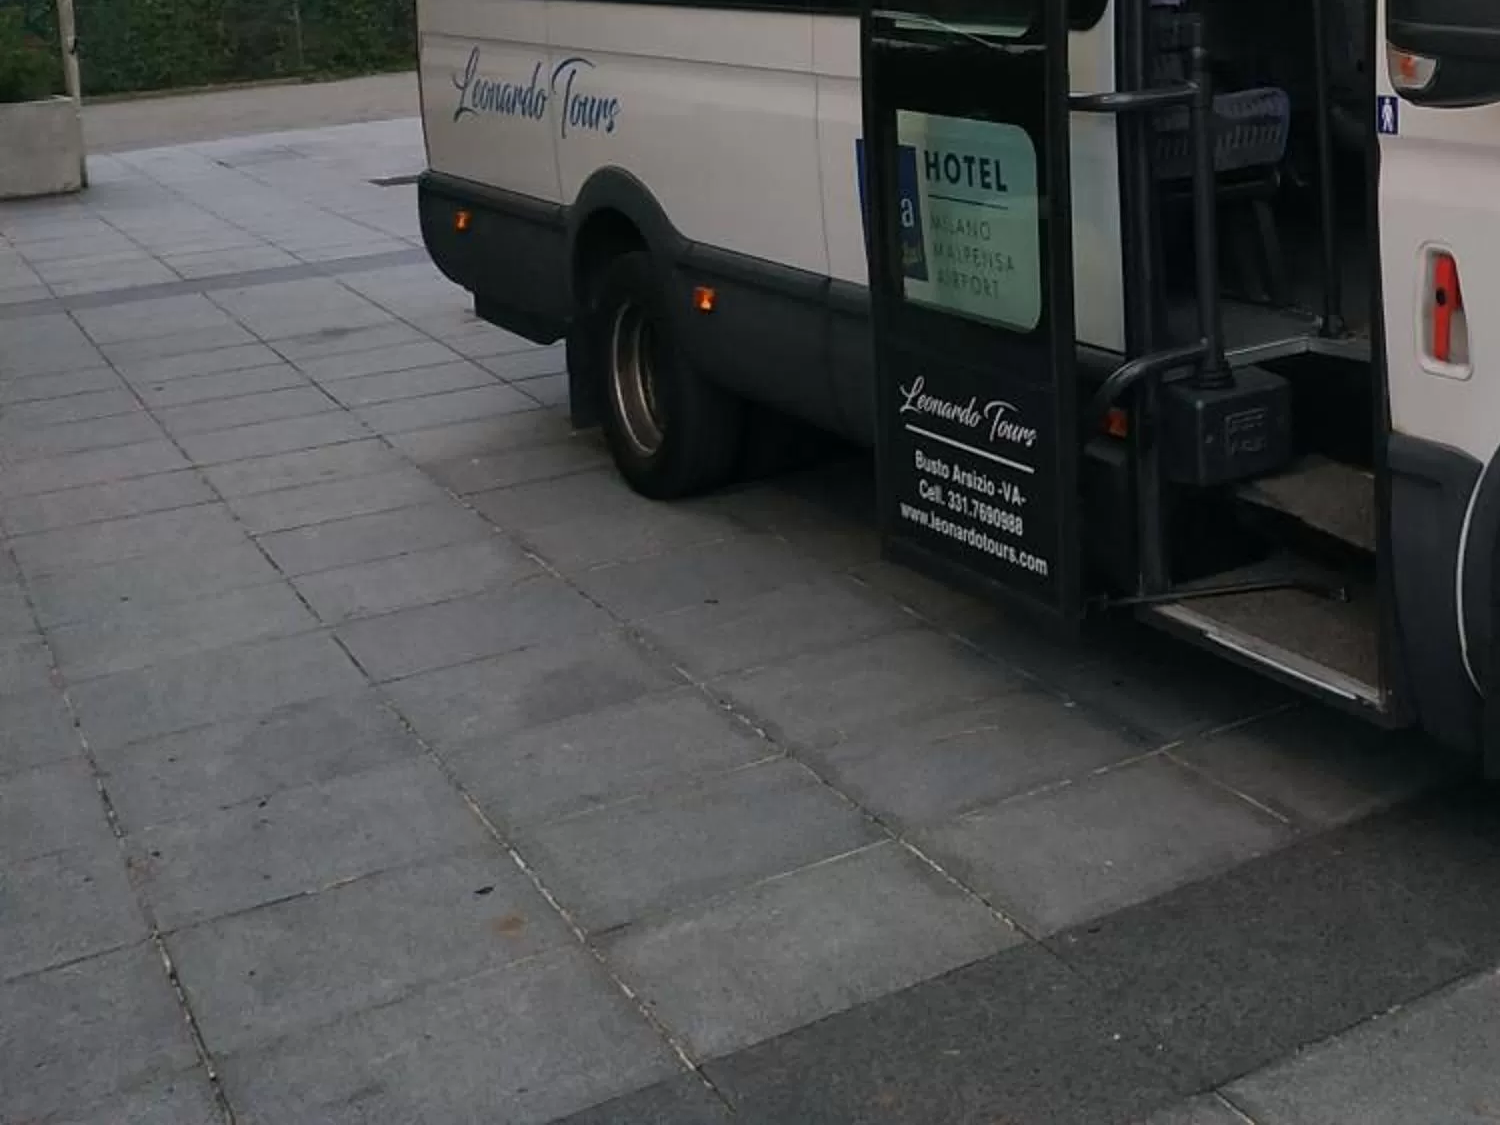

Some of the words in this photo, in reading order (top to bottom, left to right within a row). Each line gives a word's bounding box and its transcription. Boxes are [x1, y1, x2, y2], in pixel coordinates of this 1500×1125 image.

[452, 45, 547, 123] Leonardo
[551, 57, 622, 140] Tours
[924, 150, 1009, 193] HOTEL
[899, 375, 982, 428] Leonardo
[983, 400, 1038, 447] Tours
[914, 449, 950, 480] Busto
[951, 464, 996, 497] Arsizio
[918, 478, 946, 506] Cell.
[899, 502, 1049, 576] www.leonardotours.com
